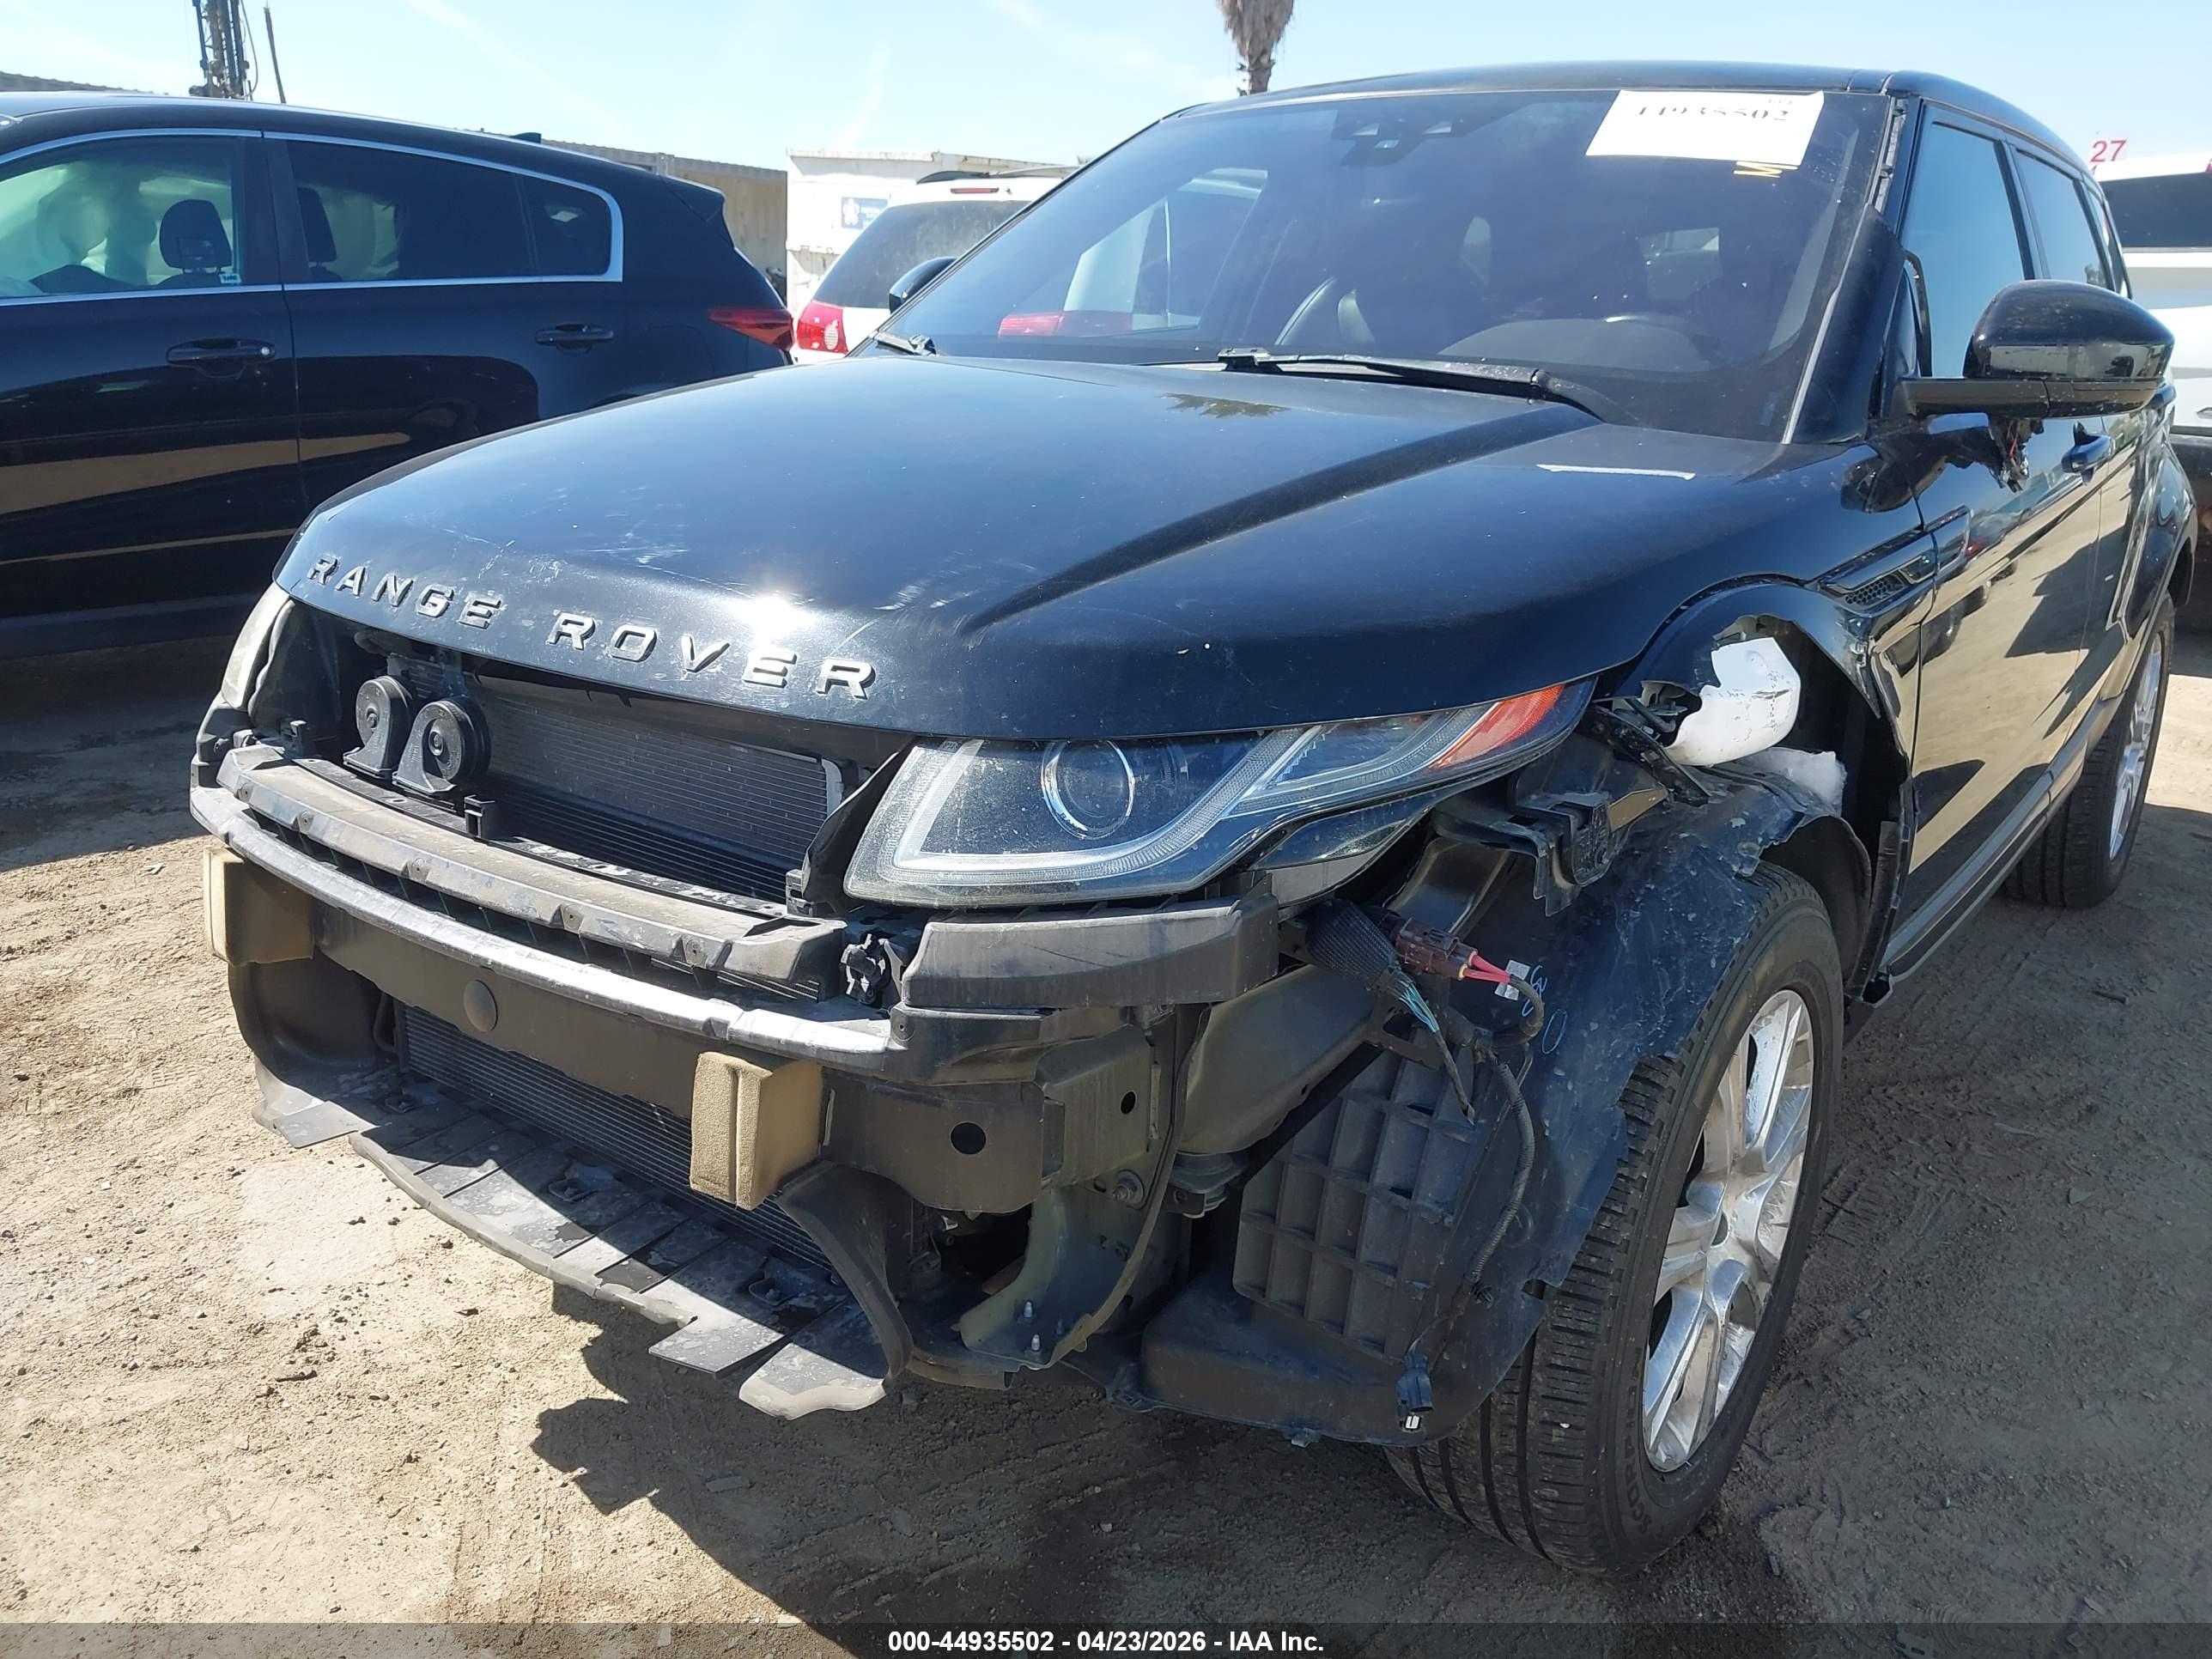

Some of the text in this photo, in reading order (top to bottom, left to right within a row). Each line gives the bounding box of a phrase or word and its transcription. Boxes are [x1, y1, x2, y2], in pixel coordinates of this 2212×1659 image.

[2090, 139, 2127, 163] 27
[307, 556, 877, 700] RANGE ROVER
